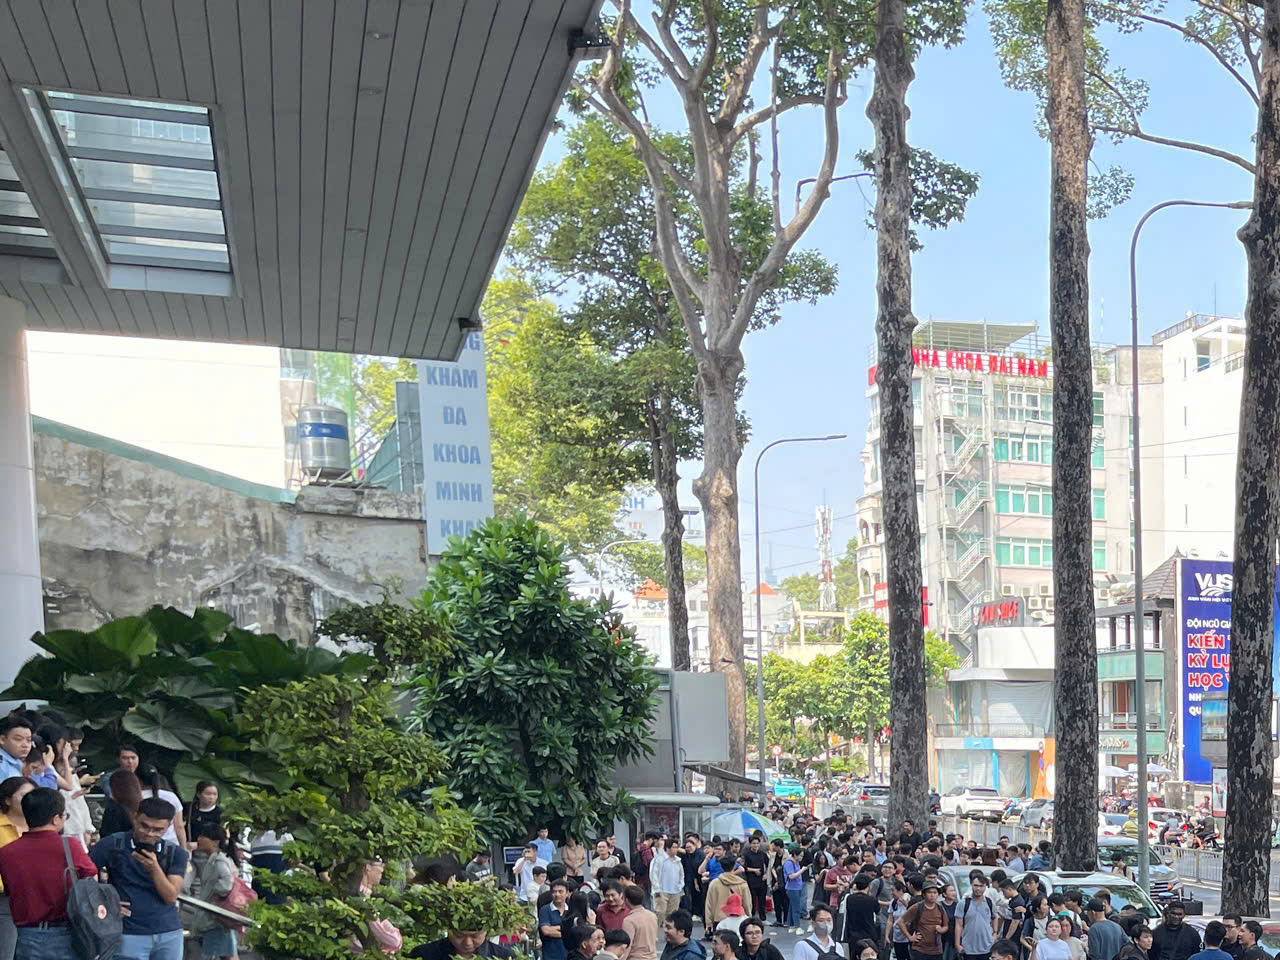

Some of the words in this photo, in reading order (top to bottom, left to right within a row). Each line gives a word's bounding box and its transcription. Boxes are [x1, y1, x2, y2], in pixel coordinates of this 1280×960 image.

[433, 444, 481, 464] KHOA
[437, 482, 483, 502] MINH
[1188, 630, 1225, 649] KIẾN
[1188, 673, 1223, 691] HỌC
